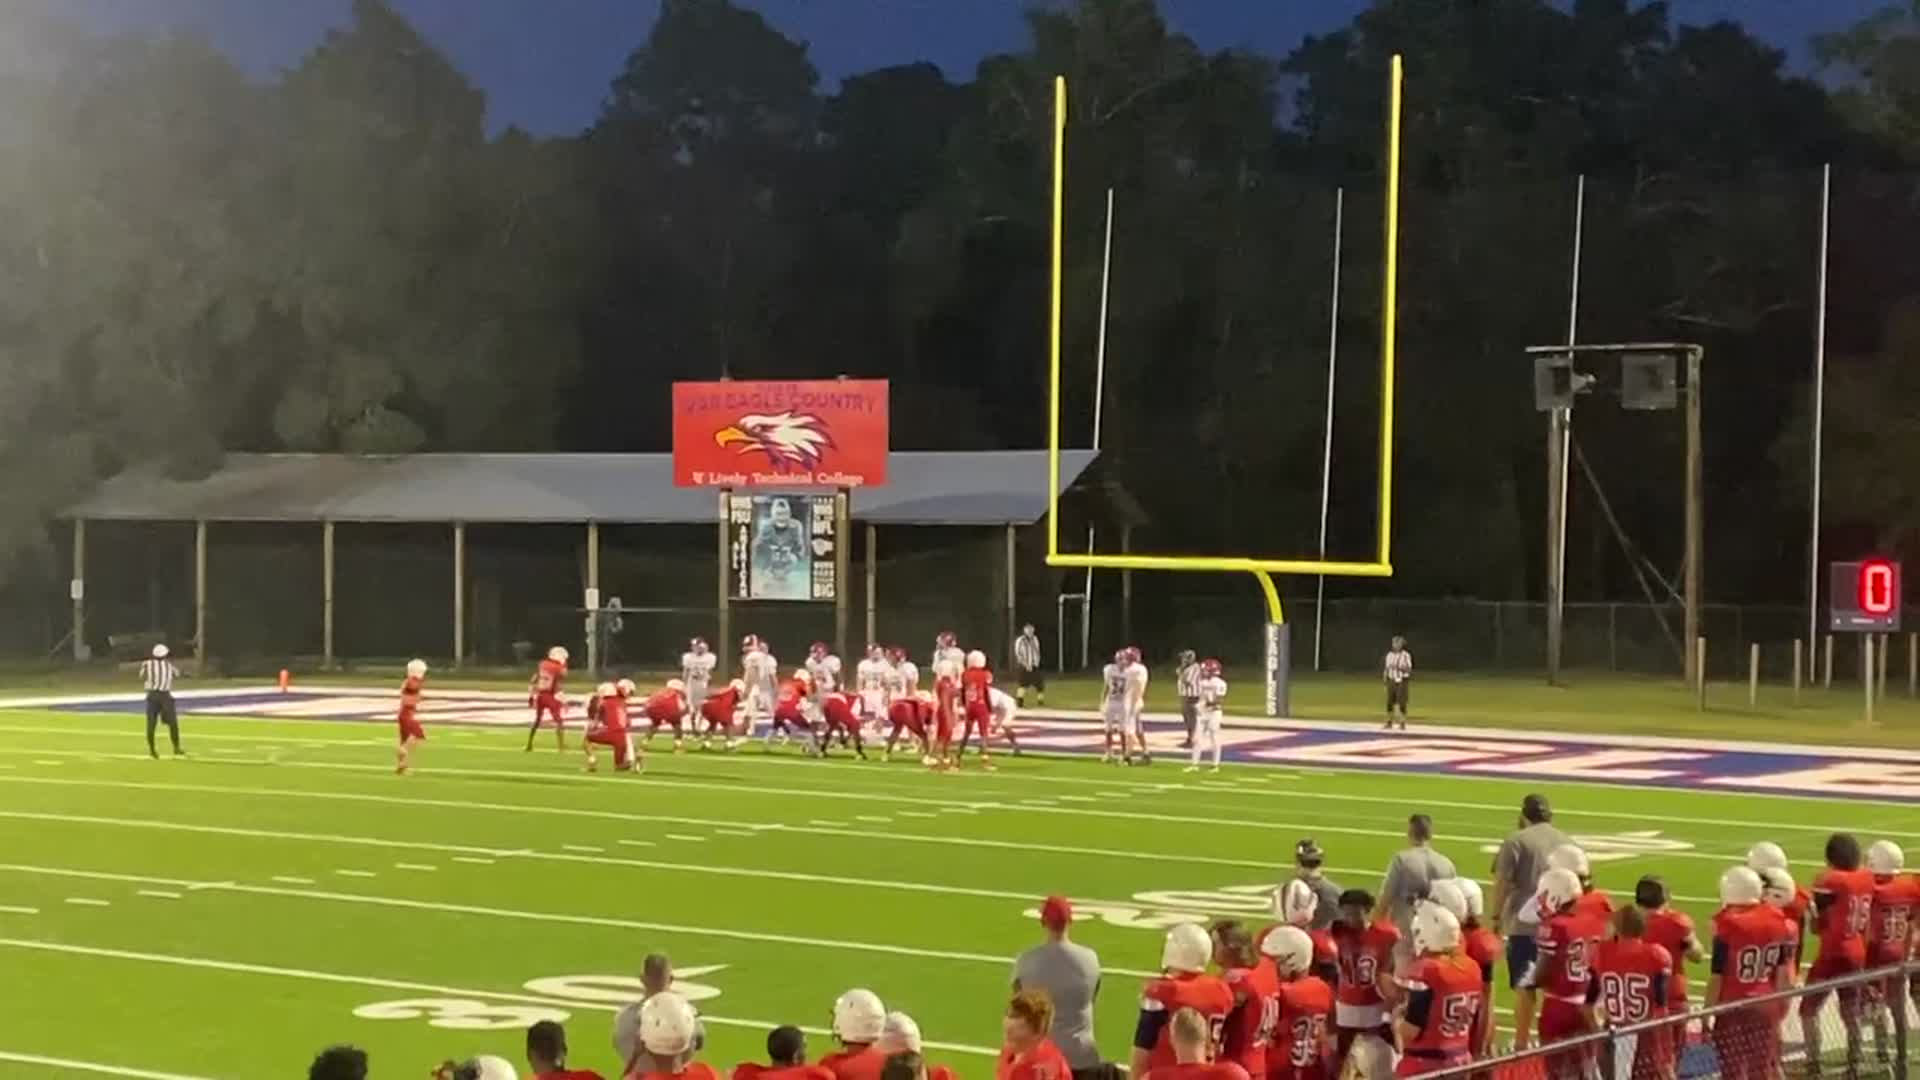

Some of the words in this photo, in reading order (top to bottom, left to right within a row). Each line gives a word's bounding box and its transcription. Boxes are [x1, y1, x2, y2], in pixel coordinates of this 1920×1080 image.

[726, 392, 783, 409] EAGLE
[791, 392, 875, 412] COUNTRY
[709, 471, 747, 486] Lively
[753, 471, 812, 485] Technical
[817, 471, 864, 486] College
[813, 583, 835, 598] BIG
[1864, 564, 1893, 613] 0
[1267, 624, 1278, 715] EAGLES
[1600, 971, 1650, 1022] 85
